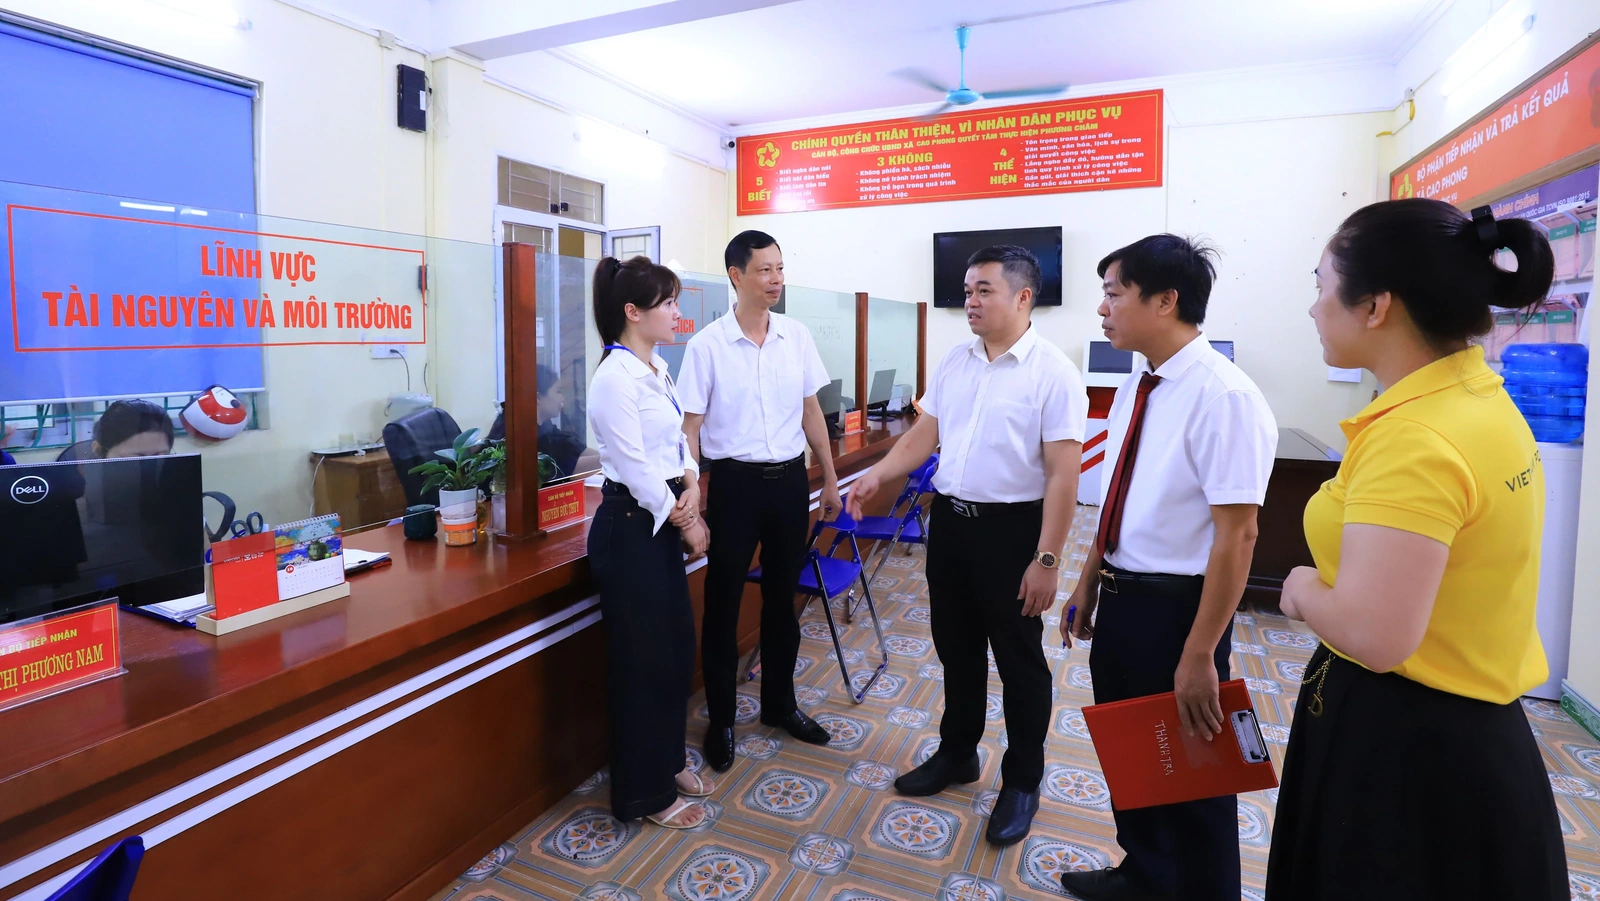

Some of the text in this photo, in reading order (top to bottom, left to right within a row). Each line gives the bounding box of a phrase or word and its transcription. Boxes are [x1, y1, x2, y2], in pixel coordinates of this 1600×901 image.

[792, 136, 827, 150] CHÍNH
[875, 128, 908, 141] THÂN
[912, 124, 954, 137] THIỆN,
[959, 120, 971, 132] VÌ
[976, 117, 1016, 131] NHÂN
[1021, 113, 1052, 126] DÂN
[1056, 109, 1096, 123] PHỤC
[1102, 106, 1121, 120] VỤ
[1416, 71, 1569, 182] BỘ PHẬN TIẾP NHẬN VÀ TRẢ KẾT QUẢ
[877, 152, 932, 166] 3 KHÔNG
[1000, 148, 1007, 156] 4
[993, 158, 1015, 171] THỂ
[756, 177, 763, 186] 5
[990, 173, 1017, 185] HIỆN
[1426, 180, 1440, 197] CAO
[1441, 166, 1468, 191] PHONG
[748, 188, 772, 201] BIẾT
[200, 240, 316, 287] LĨNH VỰC
[42, 285, 412, 330] TÀI NGUYÊN VÀ MÔI TRƯỜNG
[16, 486, 45, 495] DELL
[8, 643, 22, 653] BỘ
[25, 635, 47, 648] TIẾP
[50, 629, 77, 642] NHẬN
[22, 652, 73, 684] PHƯƠNG
[76, 643, 103, 668] NAM
